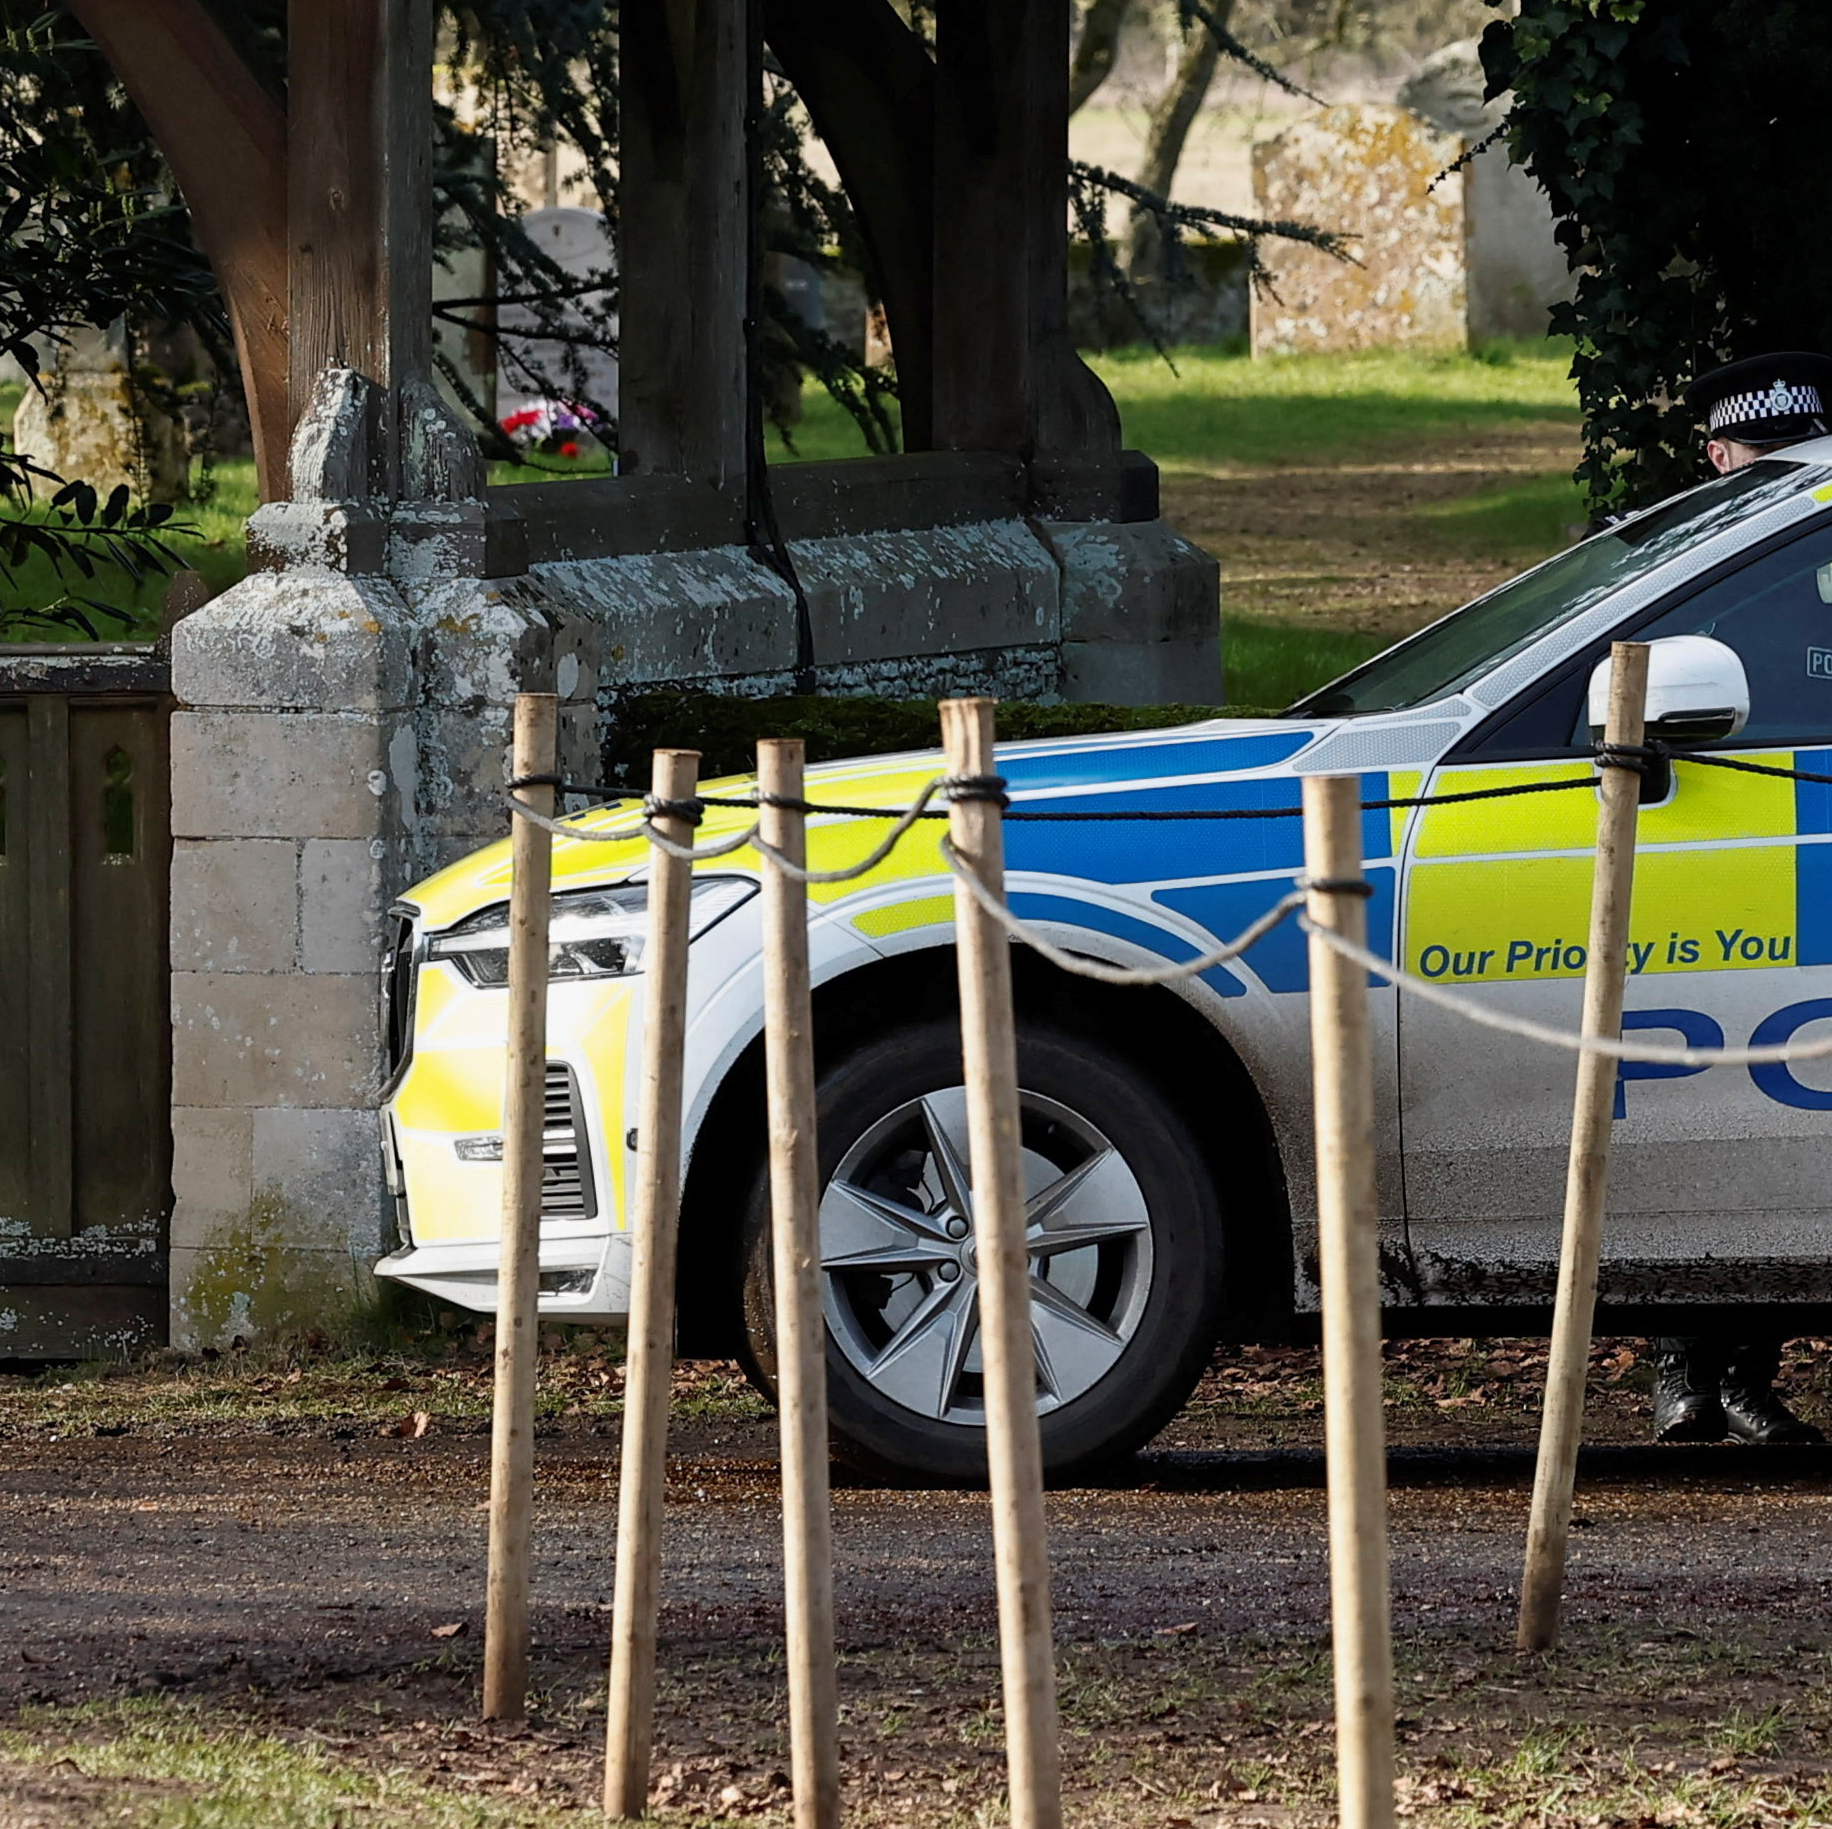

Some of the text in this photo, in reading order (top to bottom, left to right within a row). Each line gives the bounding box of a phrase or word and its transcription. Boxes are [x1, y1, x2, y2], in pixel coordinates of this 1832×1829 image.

[1419, 929, 1792, 978] Our Prioy is You
